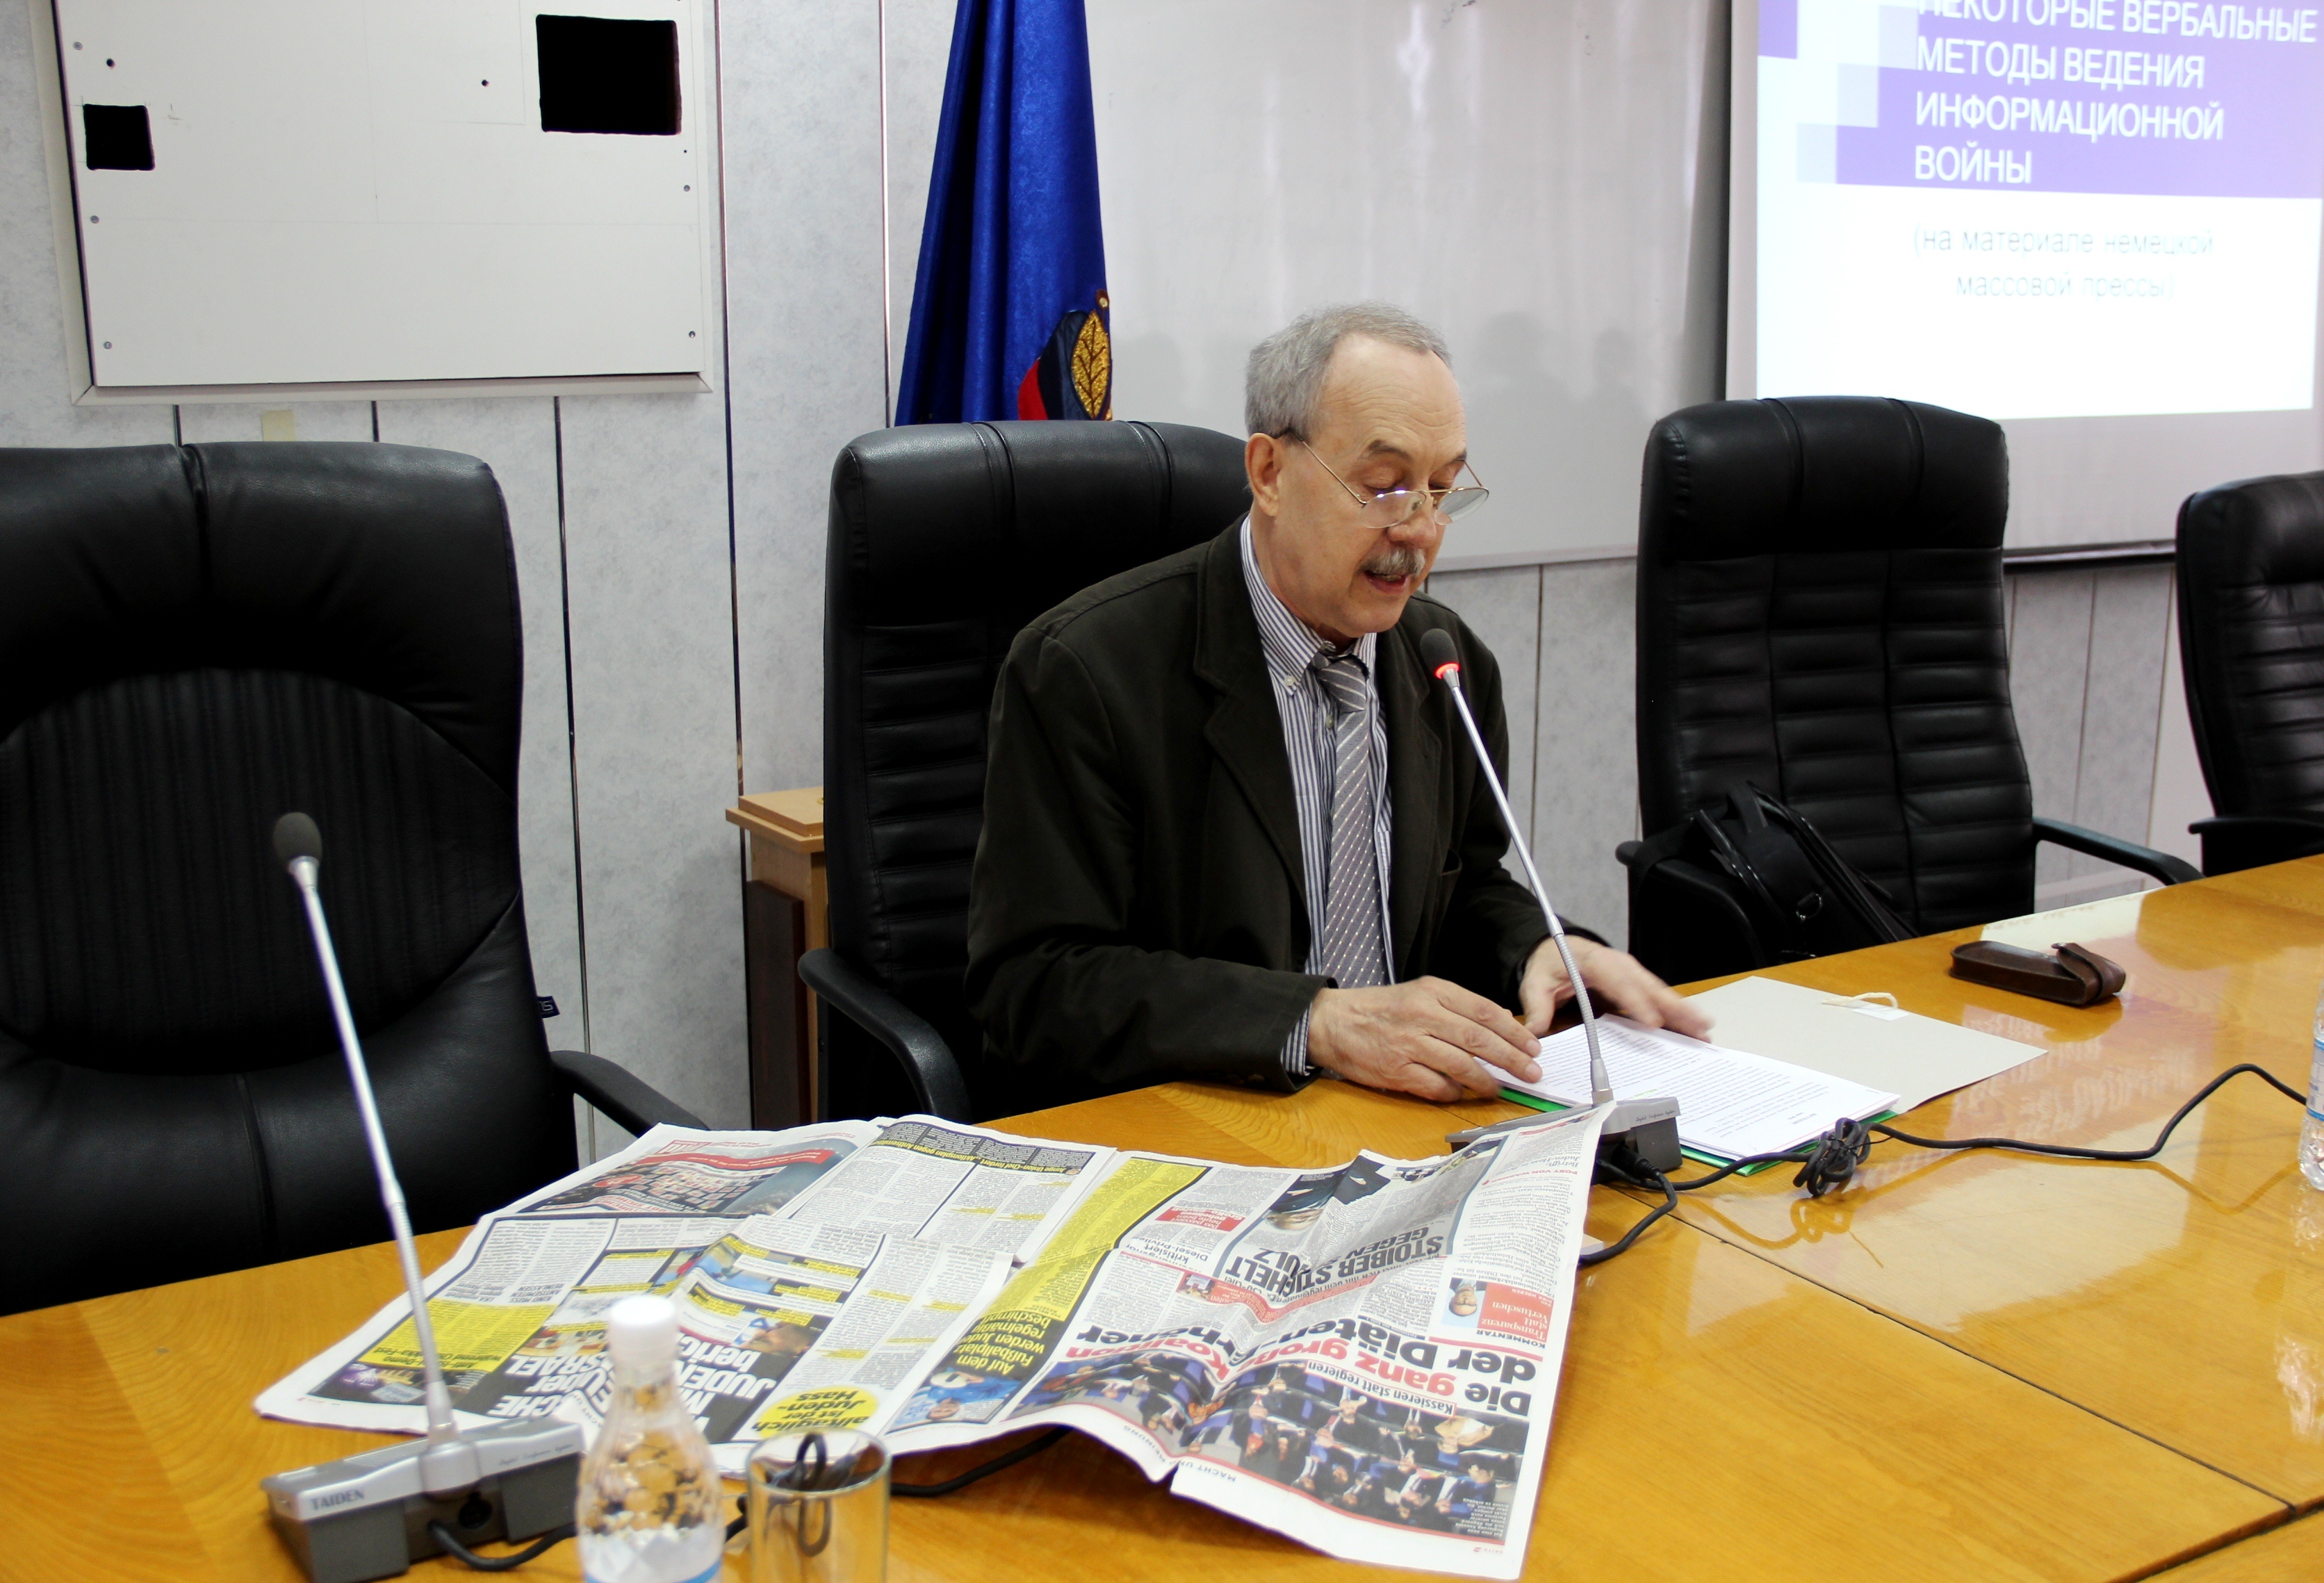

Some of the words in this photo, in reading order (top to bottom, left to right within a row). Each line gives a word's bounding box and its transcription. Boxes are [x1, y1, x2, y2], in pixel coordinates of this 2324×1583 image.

[2122, 0, 2318, 42] ВЕРБАЛЬНЫЕ
[1917, 35, 2057, 86] МЕТОДЫ
[2063, 47, 2205, 92] ВЕДЕНИЯ
[1916, 91, 2224, 143] ИНФОРМАЦИОННОЙ
[1915, 140, 2032, 183] ВОЙНЫ
[1915, 222, 1951, 259] (на
[1962, 231, 2093, 259] материале
[2104, 230, 2214, 257] немецкой
[1956, 272, 2071, 296] массовой
[2082, 272, 2175, 303] прессы)
[1144, 1244, 1189, 1264] kritisiert
[1343, 1227, 1429, 1260] GEGEN
[1337, 1236, 1444, 1278] STOIBER
[1225, 1256, 1333, 1297] STICHELT
[1492, 1302, 1548, 1324] Vertuschen
[1524, 1318, 1547, 1329] statt
[1476, 1329, 1546, 1349] KOMMENTAR
[1481, 1318, 1545, 1340] Transparenz
[953, 1343, 1033, 1367] Fußballplatz
[995, 1334, 1045, 1354] werden
[956, 1354, 988, 1369] dem
[986, 1359, 1015, 1375] Auf
[1308, 1361, 1359, 1386] regieren
[1354, 1350, 1457, 1397] ganz
[1447, 1349, 1536, 1384] der
[796, 1391, 858, 1401] Hass
[1361, 1379, 1390, 1398] statt
[1464, 1382, 1532, 1417] Die
[776, 1400, 867, 1411] Juden-
[1393, 1389, 1453, 1415] Kassieren
[781, 1411, 816, 1420] der
[1197, 1465, 1236, 1482] MACHT
[311, 1488, 365, 1511] TAIDEN
